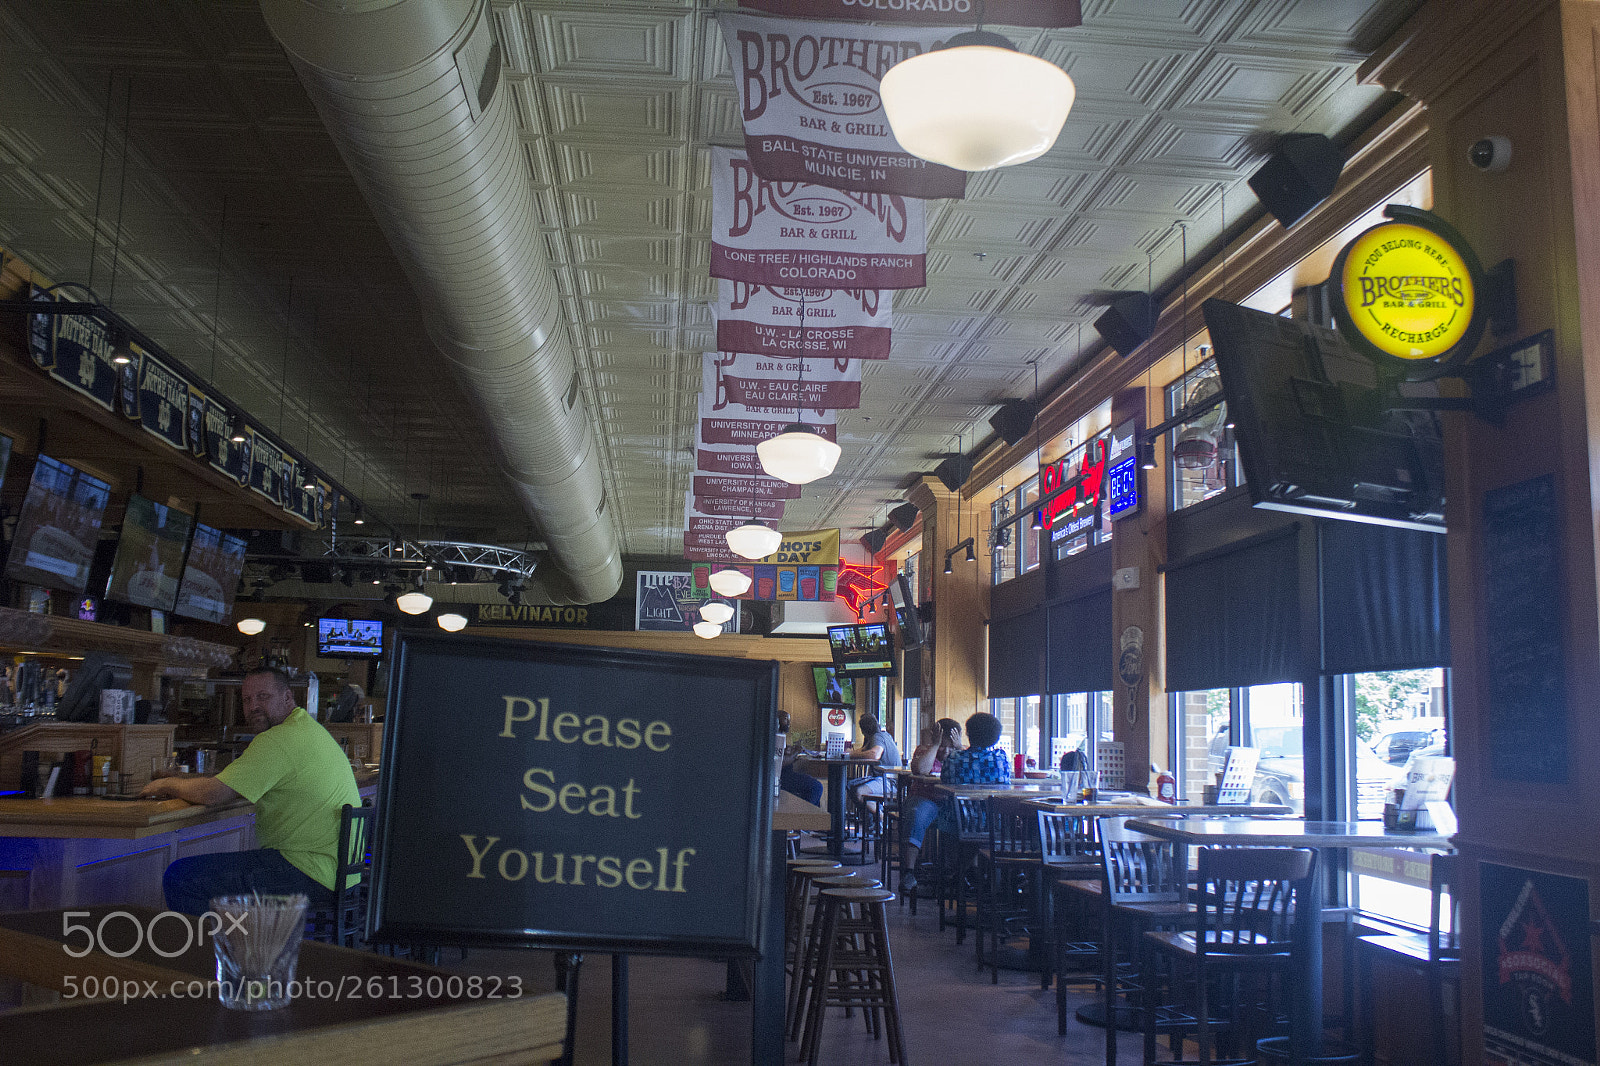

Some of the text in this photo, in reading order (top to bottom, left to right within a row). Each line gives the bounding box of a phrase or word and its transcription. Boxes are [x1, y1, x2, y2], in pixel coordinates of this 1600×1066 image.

[842, 0, 970, 13] COLORADO
[812, 90, 873, 108] Est. 1967
[800, 115, 888, 138] BAR & GRILL
[762, 140, 928, 170] BALL STATE UNIVERSITY
[805, 159, 887, 181] MUNCIE, IN
[793, 205, 844, 217] Est. 1967
[780, 227, 858, 240] BAR & GRILL
[724, 250, 913, 268] LONE TREE / HIGHLANDS RANCH
[1365, 239, 1449, 268] YOU BELONG HERE
[779, 267, 857, 280] COLORADO
[1358, 276, 1464, 308] BROTHERS
[1418, 301, 1447, 309] GRILL
[772, 306, 793, 316] BAR
[806, 308, 837, 318] GRILL
[755, 326, 779, 338] U.W.
[788, 330, 802, 339] LA
[806, 329, 854, 340] CROSSE
[1382, 322, 1449, 344] RECHARGE
[762, 337, 847, 351] LA CROSSE, WI
[756, 362, 812, 372] BAR & GRILL
[739, 381, 761, 390] U.W.
[769, 383, 790, 391] EAU
[792, 383, 828, 393] CLAIRE
[745, 391, 766, 400] EAU
[809, 393, 821, 401] WI
[771, 407, 795, 415] GRILL
[711, 421, 761, 430] UNIVERSITY
[763, 423, 776, 431] OF
[706, 478, 748, 486] UNIVERSITY
[750, 500, 776, 508] KANSAS
[781, 541, 821, 551] HOTS
[777, 552, 811, 563] DAY
[478, 604, 588, 623] KELVINATOR
[646, 606, 674, 618] LIGHT
[499, 695, 672, 752] Please
[520, 768, 642, 819] Seat
[460, 834, 696, 893] Yourself
